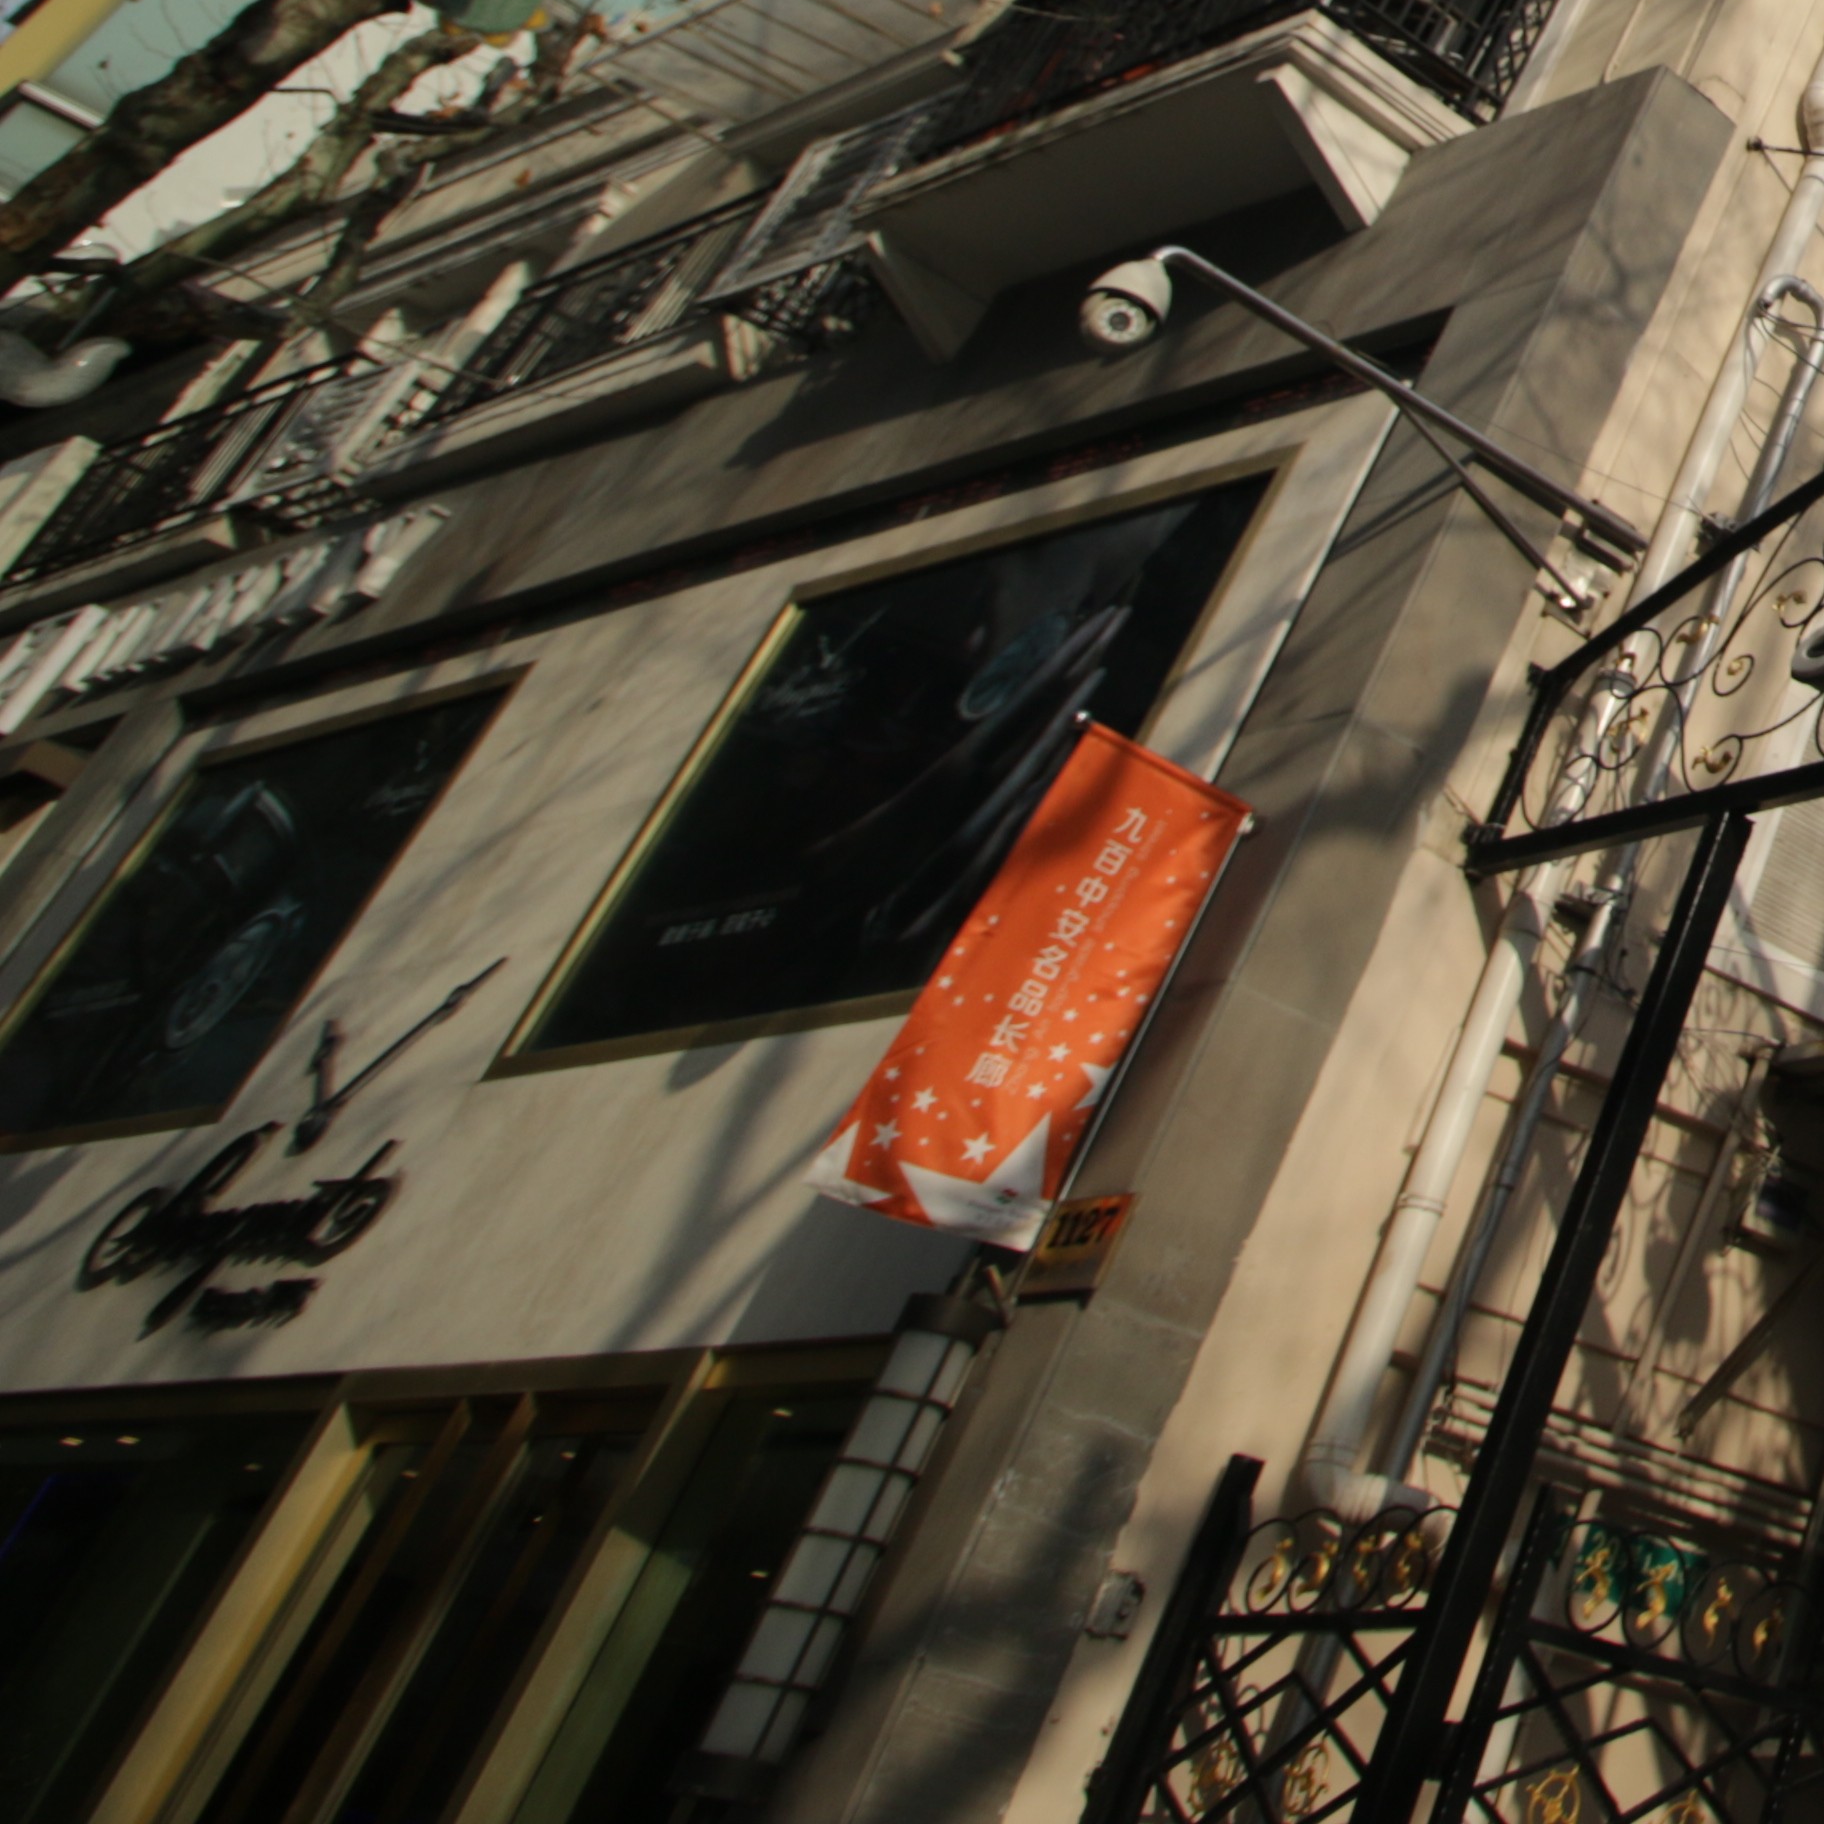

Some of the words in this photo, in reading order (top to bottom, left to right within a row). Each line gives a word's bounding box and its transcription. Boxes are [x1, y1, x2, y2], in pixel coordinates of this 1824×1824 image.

[964, 806, 1149, 1089] 九百中安名品长廊
[1049, 1207, 1118, 1248] 1127
